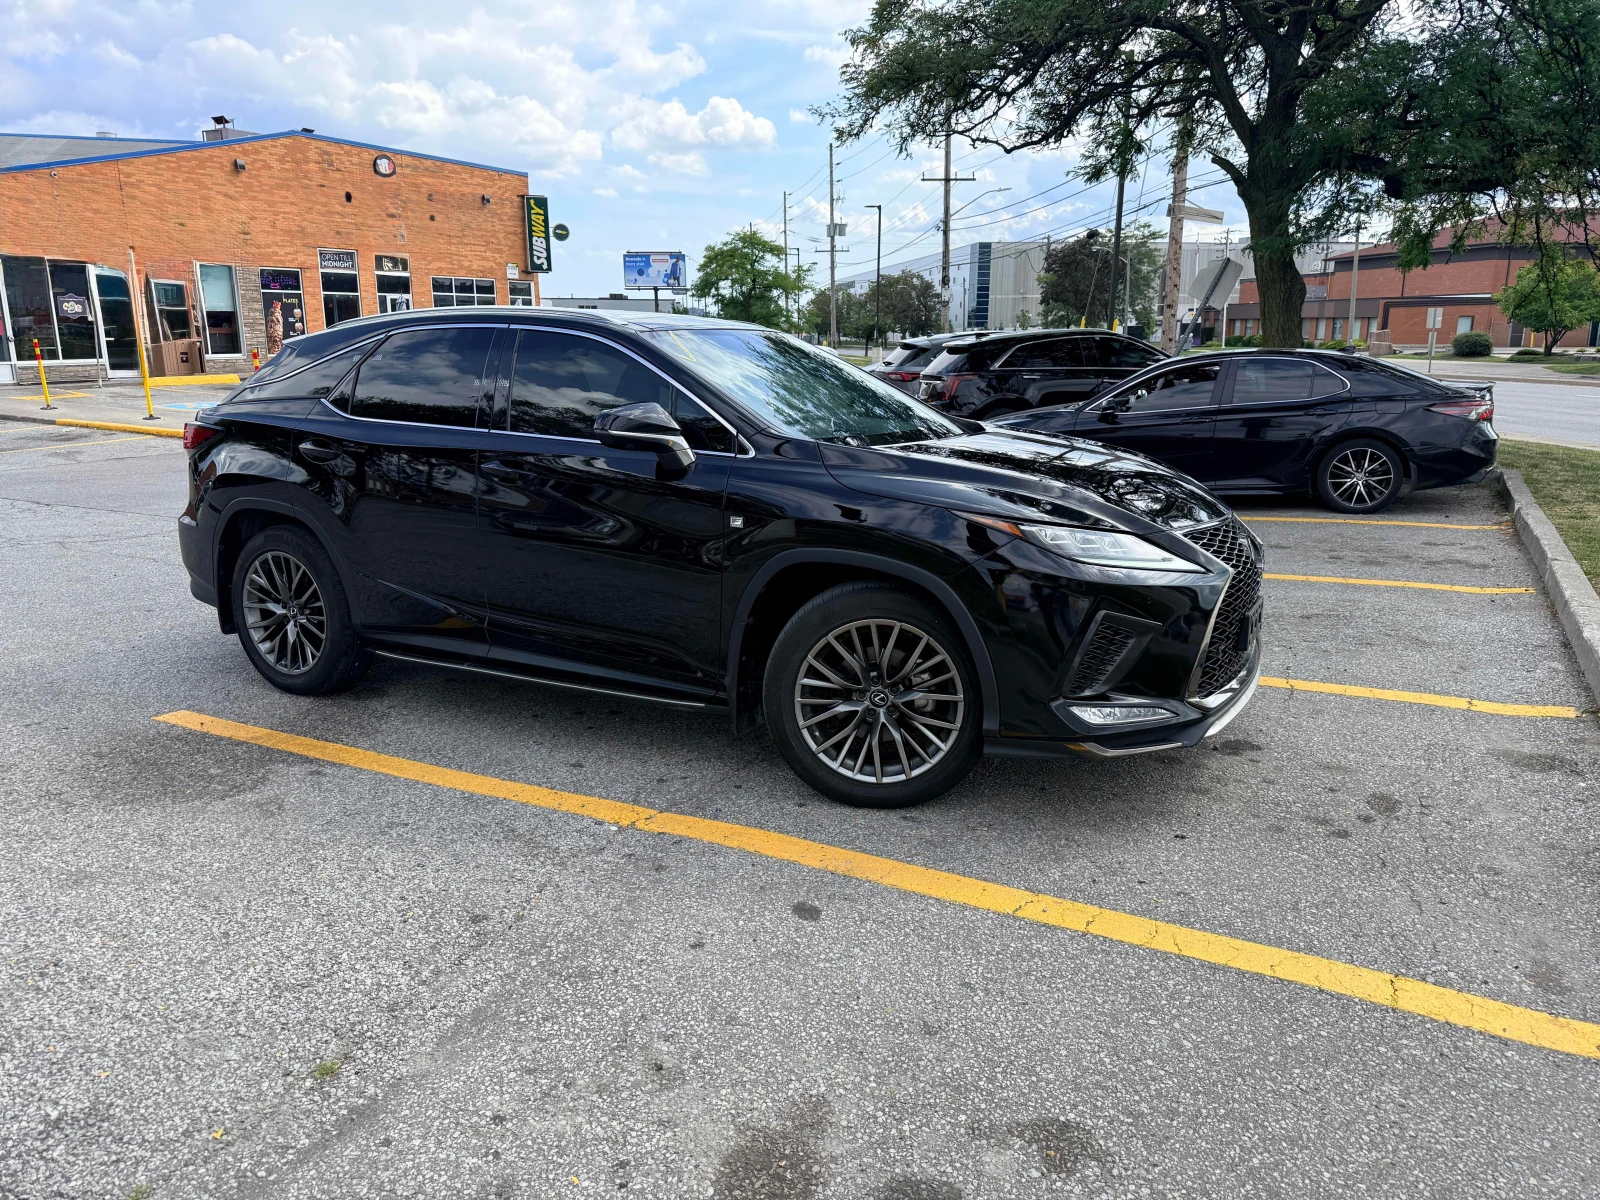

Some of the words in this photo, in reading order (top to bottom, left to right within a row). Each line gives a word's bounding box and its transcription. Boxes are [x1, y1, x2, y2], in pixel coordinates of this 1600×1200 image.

[529, 198, 548, 270] SUBWAY
[321, 253, 339, 261] OPEN
[339, 254, 352, 262] TILL
[321, 260, 353, 269] MIDNIGHT
